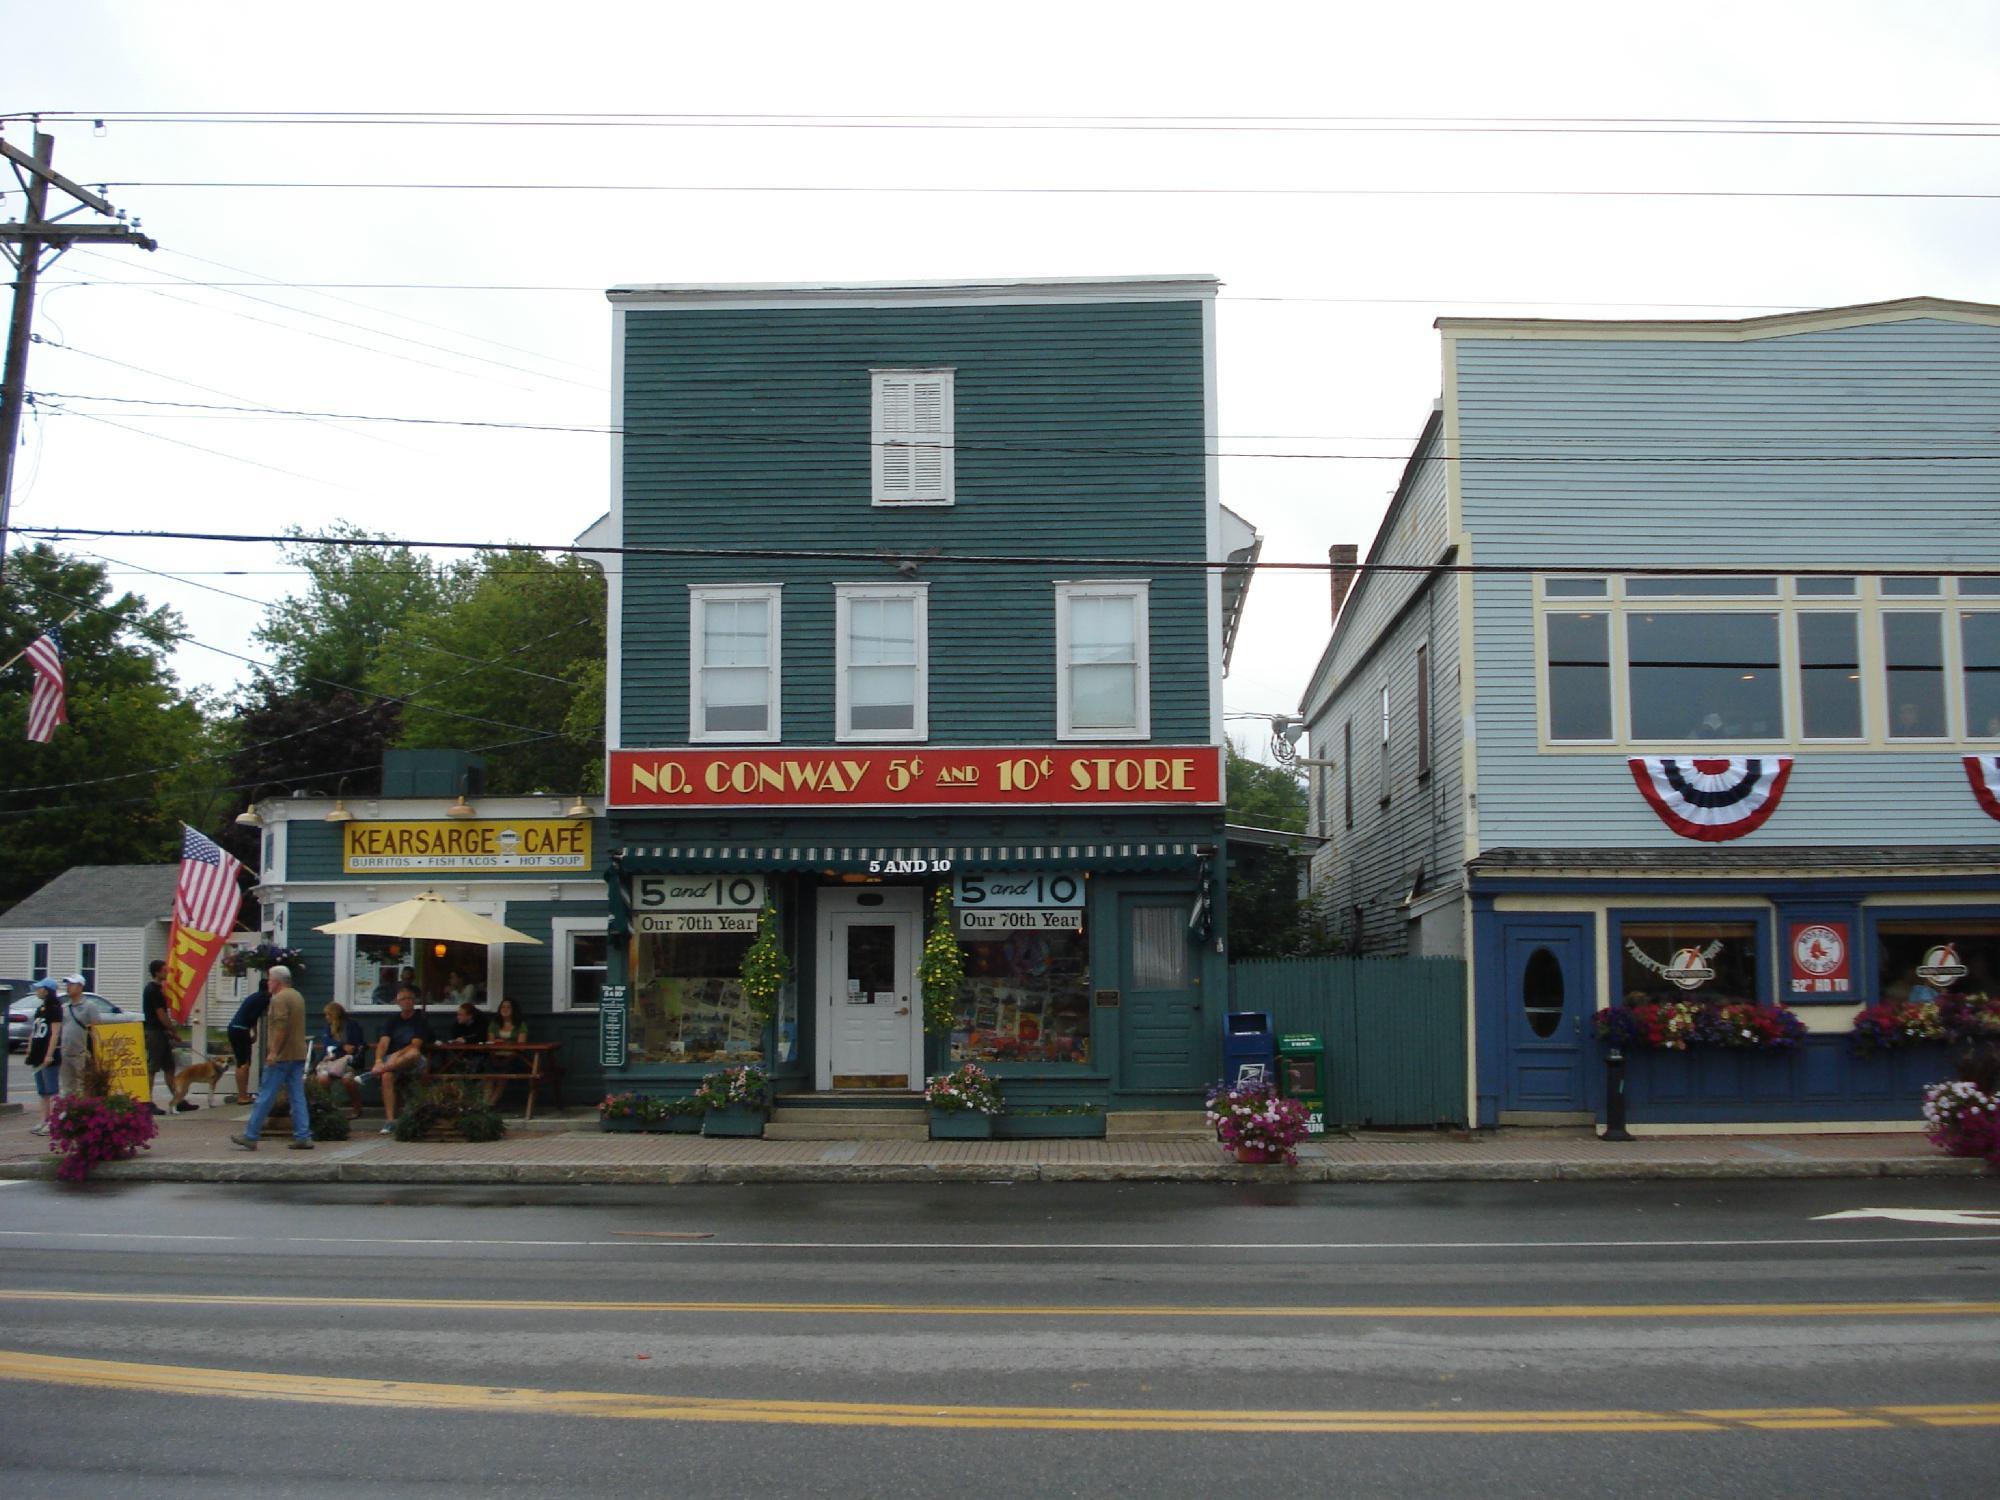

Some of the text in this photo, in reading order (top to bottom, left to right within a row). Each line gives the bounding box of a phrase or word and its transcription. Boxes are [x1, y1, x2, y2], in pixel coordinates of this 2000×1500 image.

[632, 755, 1196, 794] NO. CONWAY 5¢ AND 10¢ STORE
[351, 821, 584, 855] KEARSARGE CAFÉ
[352, 855, 581, 868] BURRITOS FISH TACOS HOT SOUP
[869, 859, 952, 873] 5 AND 10
[641, 878, 756, 906] 5 and 10
[961, 875, 1078, 904] 5 and 10
[642, 915, 754, 931] Our 70th Year
[963, 912, 1079, 927] Our 70th Year
